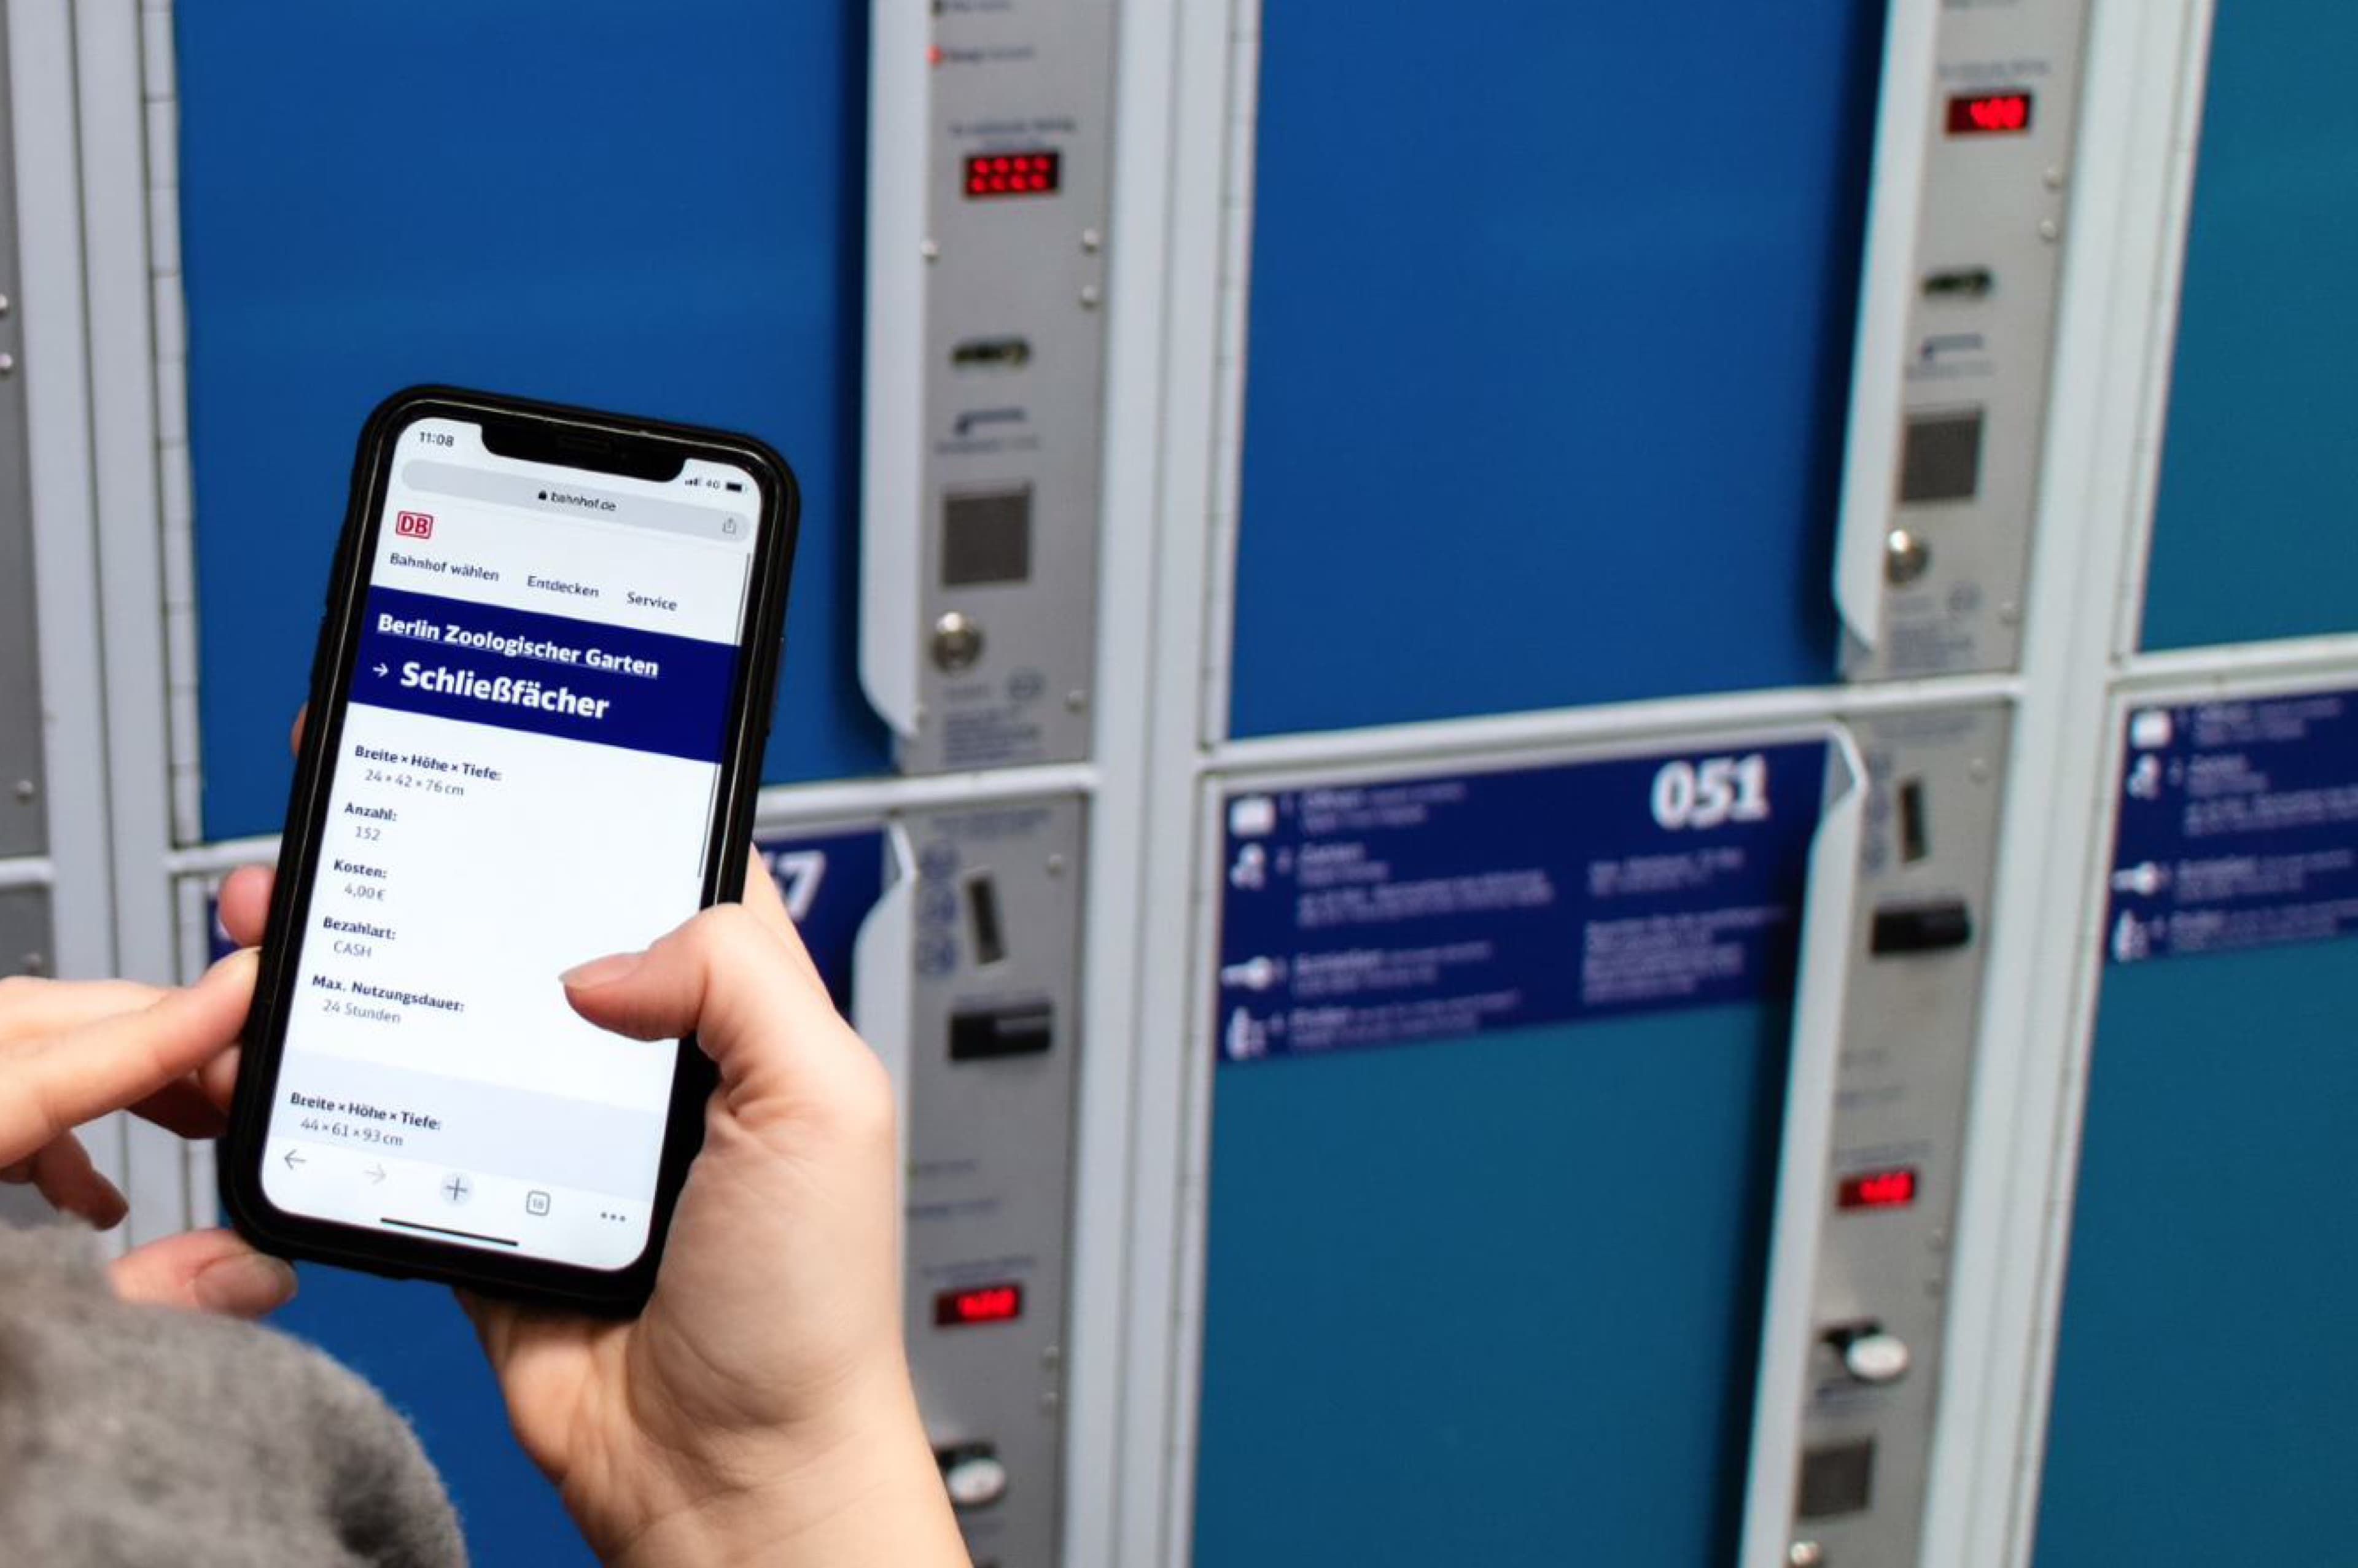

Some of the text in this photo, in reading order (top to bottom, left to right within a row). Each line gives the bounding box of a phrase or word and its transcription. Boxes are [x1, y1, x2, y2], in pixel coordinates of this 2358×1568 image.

[419, 432, 454, 447] 11:08
[550, 492, 617, 511] bahnhof.de
[399, 514, 429, 535] DB
[390, 553, 499, 582] Bahnhof wählen
[527, 575, 599, 597] Entdecken
[626, 592, 677, 611] Service
[378, 613, 660, 677] Berlin Zoologischer Garten
[400, 661, 610, 719] Schließfächer
[355, 745, 398, 763] Breite
[411, 753, 449, 772] Höhe
[462, 763, 502, 781] Tiefe:
[365, 769, 382, 782] 24
[395, 774, 413, 788] 42
[1651, 753, 1770, 830] 051
[344, 802, 397, 821] Anzahl:
[355, 826, 381, 841] 152
[333, 858, 387, 879] Kosten:
[323, 915, 396, 941] Bezahlart:
[333, 941, 372, 958] CASH
[312, 974, 464, 1012] Max. Nutzungsdauer:
[322, 999, 401, 1024] 24 Stunden
[290, 1092, 335, 1111] Breite
[348, 1103, 386, 1120] Höhe
[401, 1111, 440, 1130] Tiefe:
[300, 1117, 319, 1131] 44
[332, 1122, 349, 1137] 61
